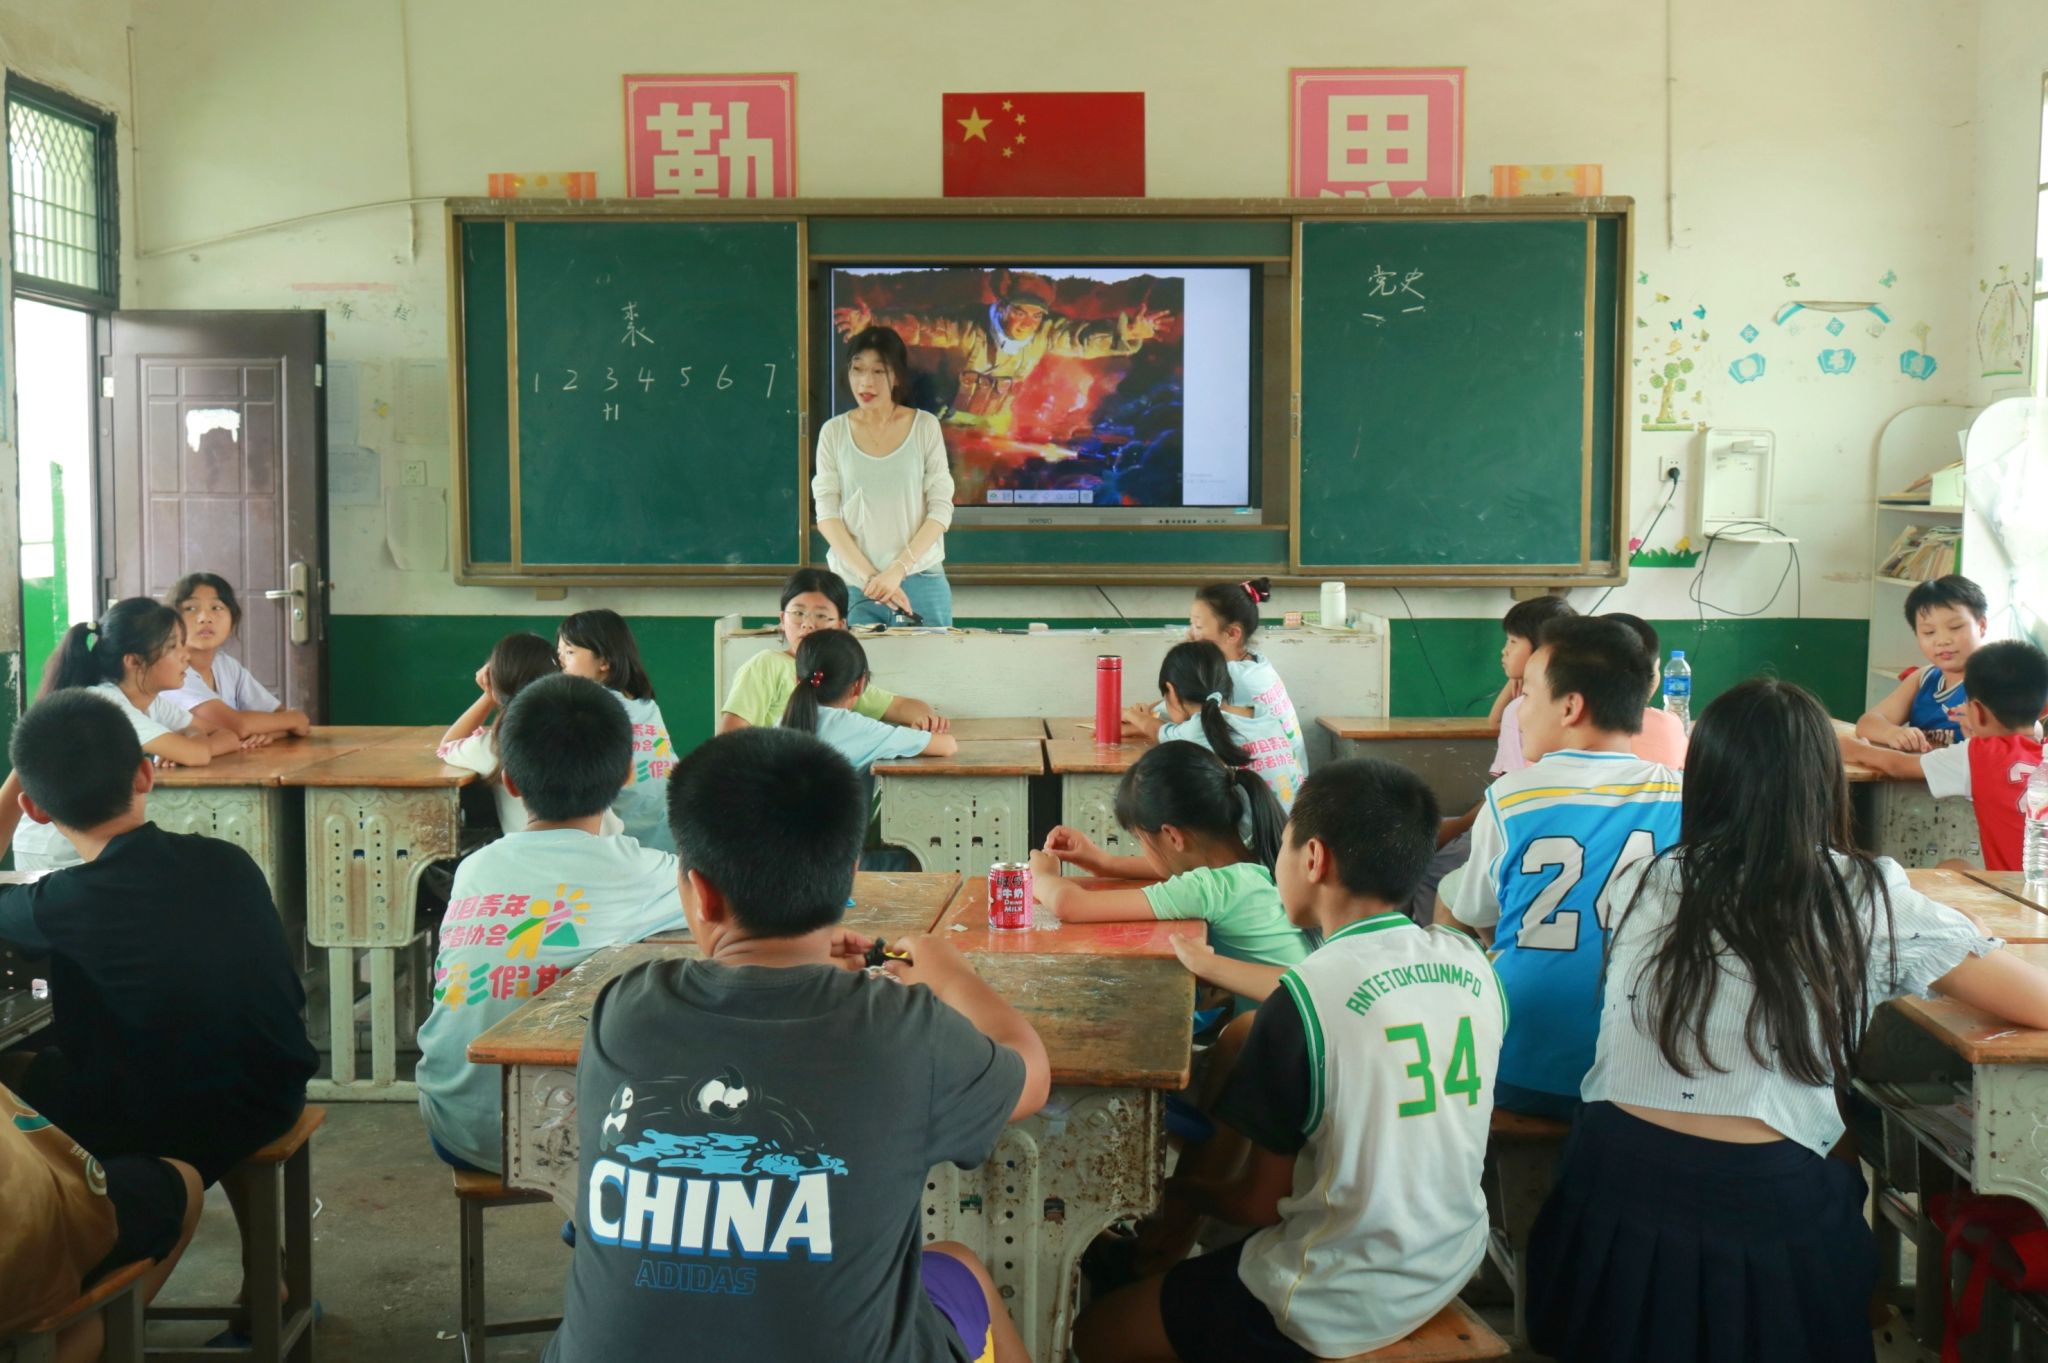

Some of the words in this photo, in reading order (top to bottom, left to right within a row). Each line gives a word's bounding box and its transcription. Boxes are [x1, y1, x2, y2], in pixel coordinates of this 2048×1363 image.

[1367, 264, 1426, 299] 党史
[533, 372, 539, 393] 1
[562, 368, 578, 390] 2
[603, 366, 619, 391] 3
[638, 366, 655, 392] 4
[679, 366, 693, 387] 5
[716, 364, 733, 389] 6
[764, 363, 776, 398] 7
[1345, 962, 1482, 1017] ANTETOKOUNMPO
[1384, 1015, 1483, 1119] 34
[588, 1158, 833, 1262] CHINA
[634, 1260, 759, 1296] ADIDAS
